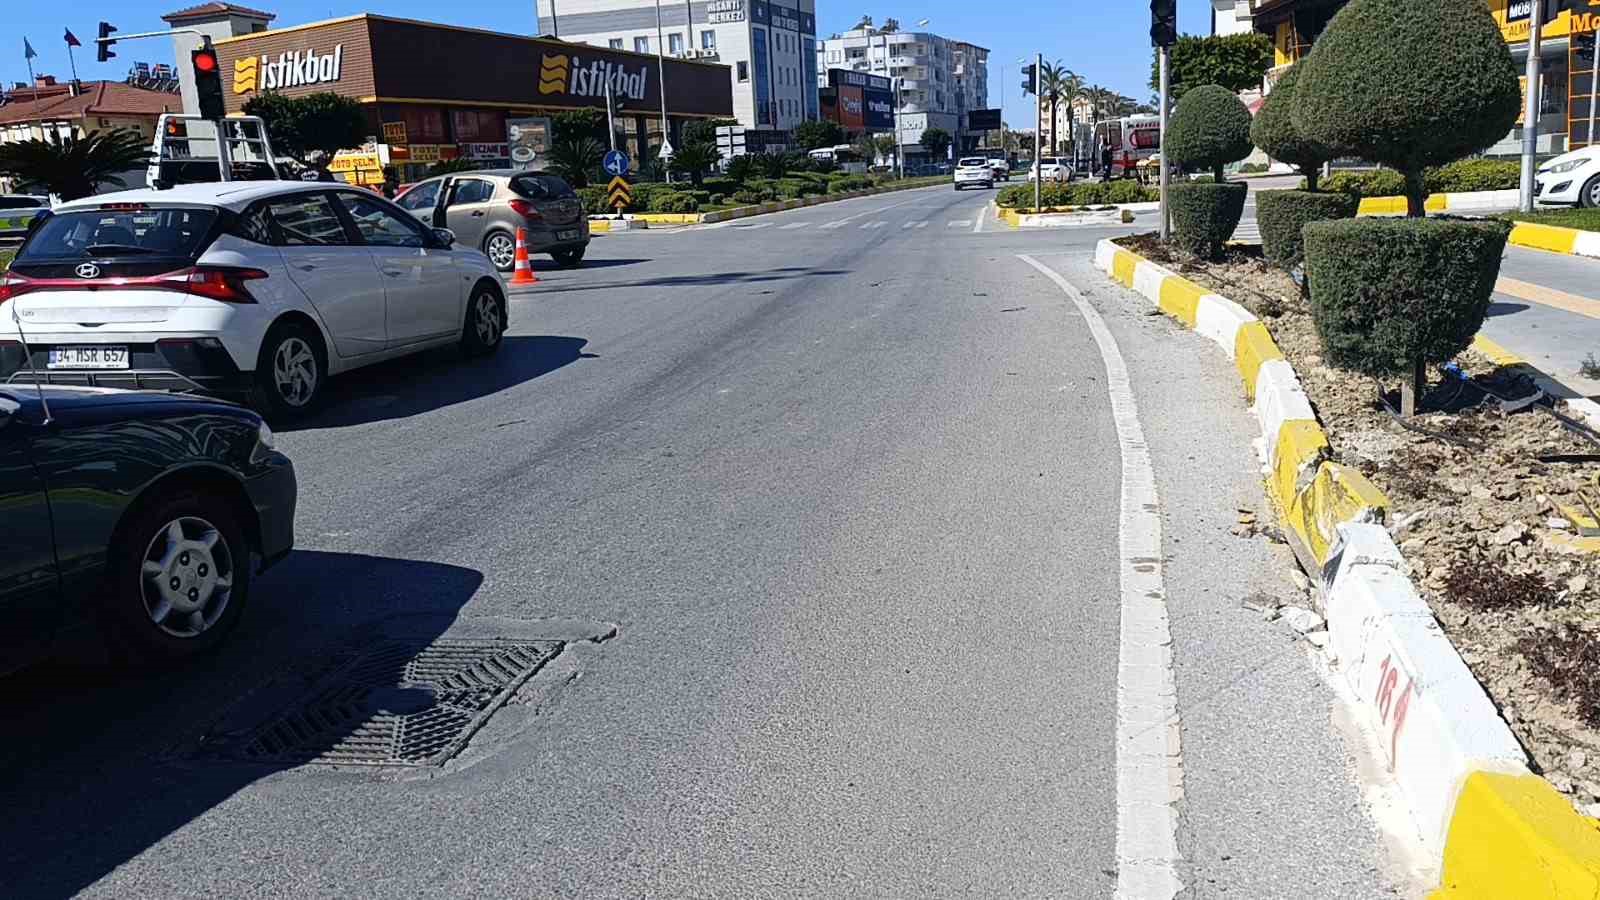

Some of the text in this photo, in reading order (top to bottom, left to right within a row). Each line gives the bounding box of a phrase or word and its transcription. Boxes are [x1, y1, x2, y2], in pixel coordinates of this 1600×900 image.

[260, 44, 342, 90] istikbal
[570, 56, 647, 99] istikbal
[57, 347, 70, 362] 34
[103, 347, 126, 362] 657
